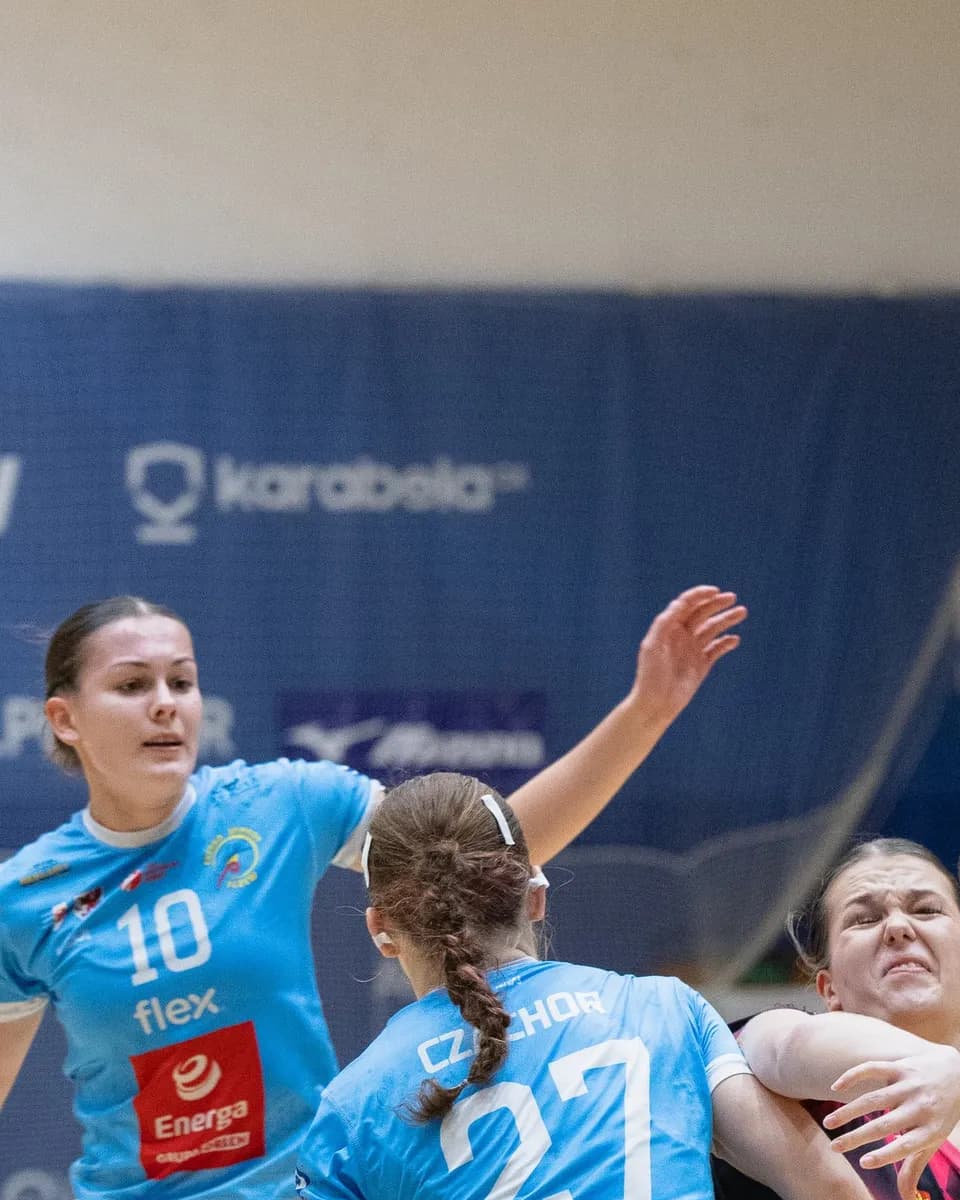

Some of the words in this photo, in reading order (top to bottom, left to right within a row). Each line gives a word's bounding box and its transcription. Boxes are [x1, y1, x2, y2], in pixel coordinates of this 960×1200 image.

[117, 887, 213, 987] 10
[133, 987, 220, 1035] flex
[417, 991, 606, 1074] CZCHOR
[154, 1100, 249, 1140] Energa
